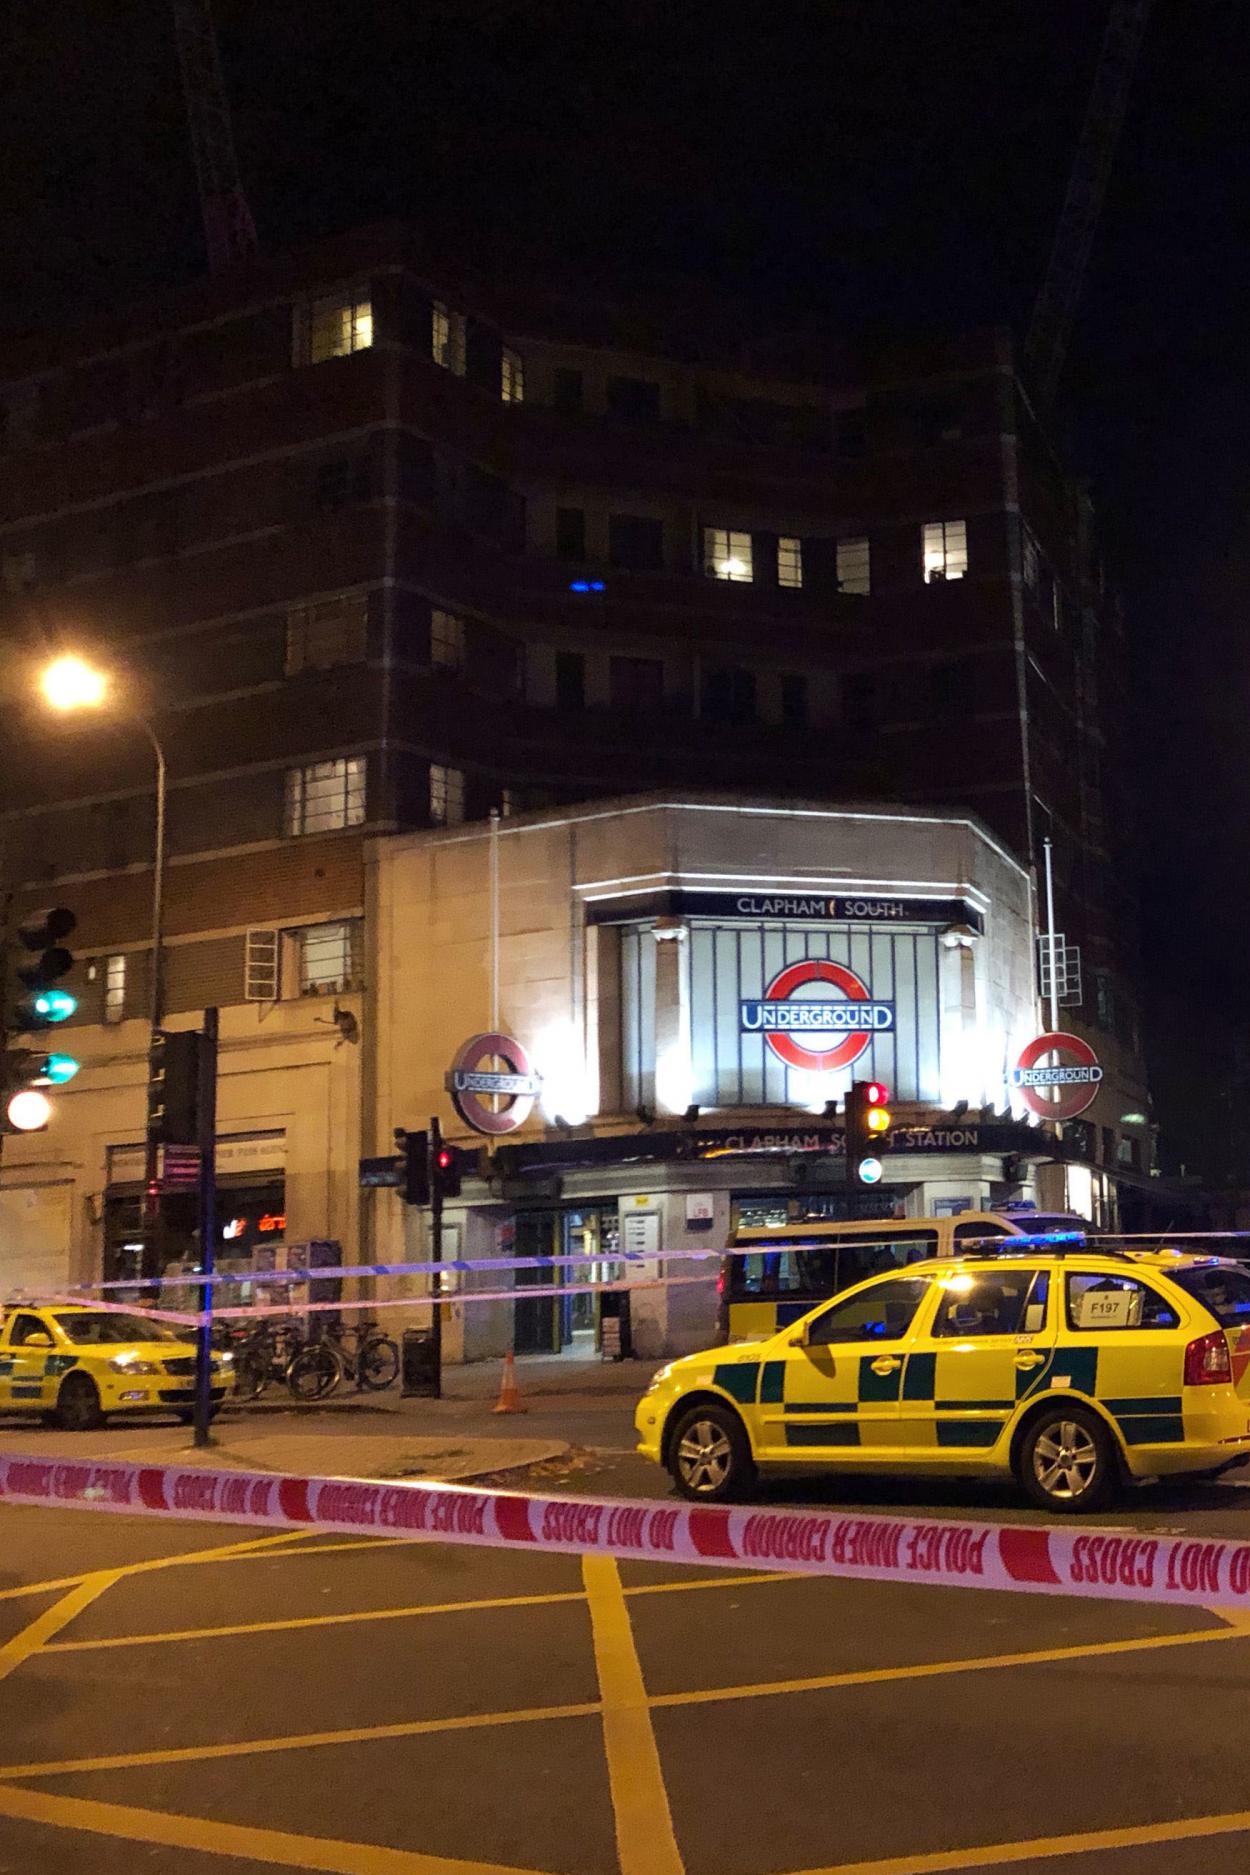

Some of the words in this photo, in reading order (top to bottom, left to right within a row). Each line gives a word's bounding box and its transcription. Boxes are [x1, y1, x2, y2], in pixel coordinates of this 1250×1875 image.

[737, 898, 825, 916] CLAPHAM
[844, 901, 903, 917] SOUTH
[742, 1004, 893, 1029] UNDERGROUND
[1010, 1066, 1103, 1087] UNDERGROUND
[905, 1130, 978, 1147] STATION
[1091, 1302, 1120, 1313] F197
[543, 1501, 602, 1545] CROSS
[607, 1506, 647, 1548] NOT
[648, 1509, 680, 1551] DO
[742, 1514, 831, 1562] CORDON
[832, 1519, 905, 1568] INNER
[906, 1525, 990, 1575] POLICE
[1070, 1535, 1159, 1588] CROSS
[1165, 1541, 1226, 1593] NOT
